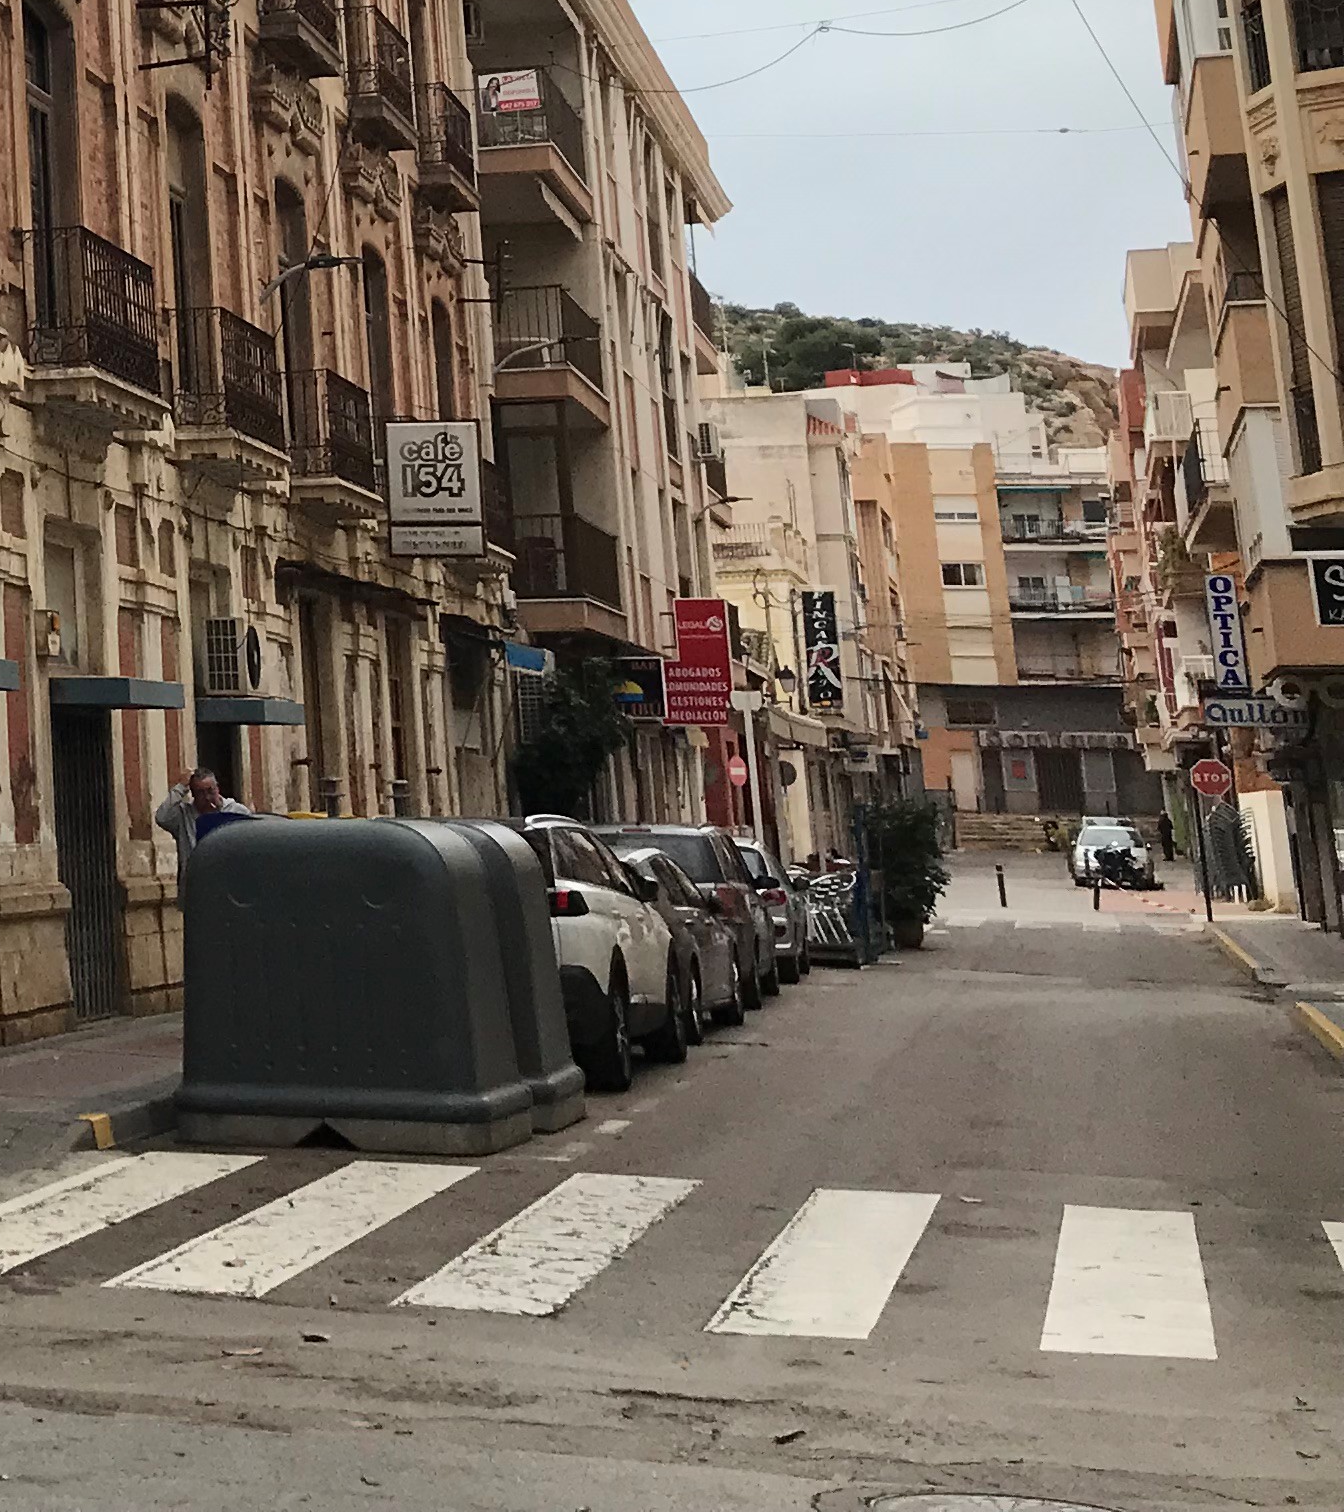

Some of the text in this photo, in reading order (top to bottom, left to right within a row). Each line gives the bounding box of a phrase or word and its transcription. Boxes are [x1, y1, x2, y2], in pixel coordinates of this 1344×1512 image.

[401, 462, 466, 498] 154
[1208, 576, 1243, 686] OPTICA
[668, 667, 722, 678] ABOGADOS
[670, 696, 724, 707] GESTIONES
[1193, 772, 1229, 783] STOP
